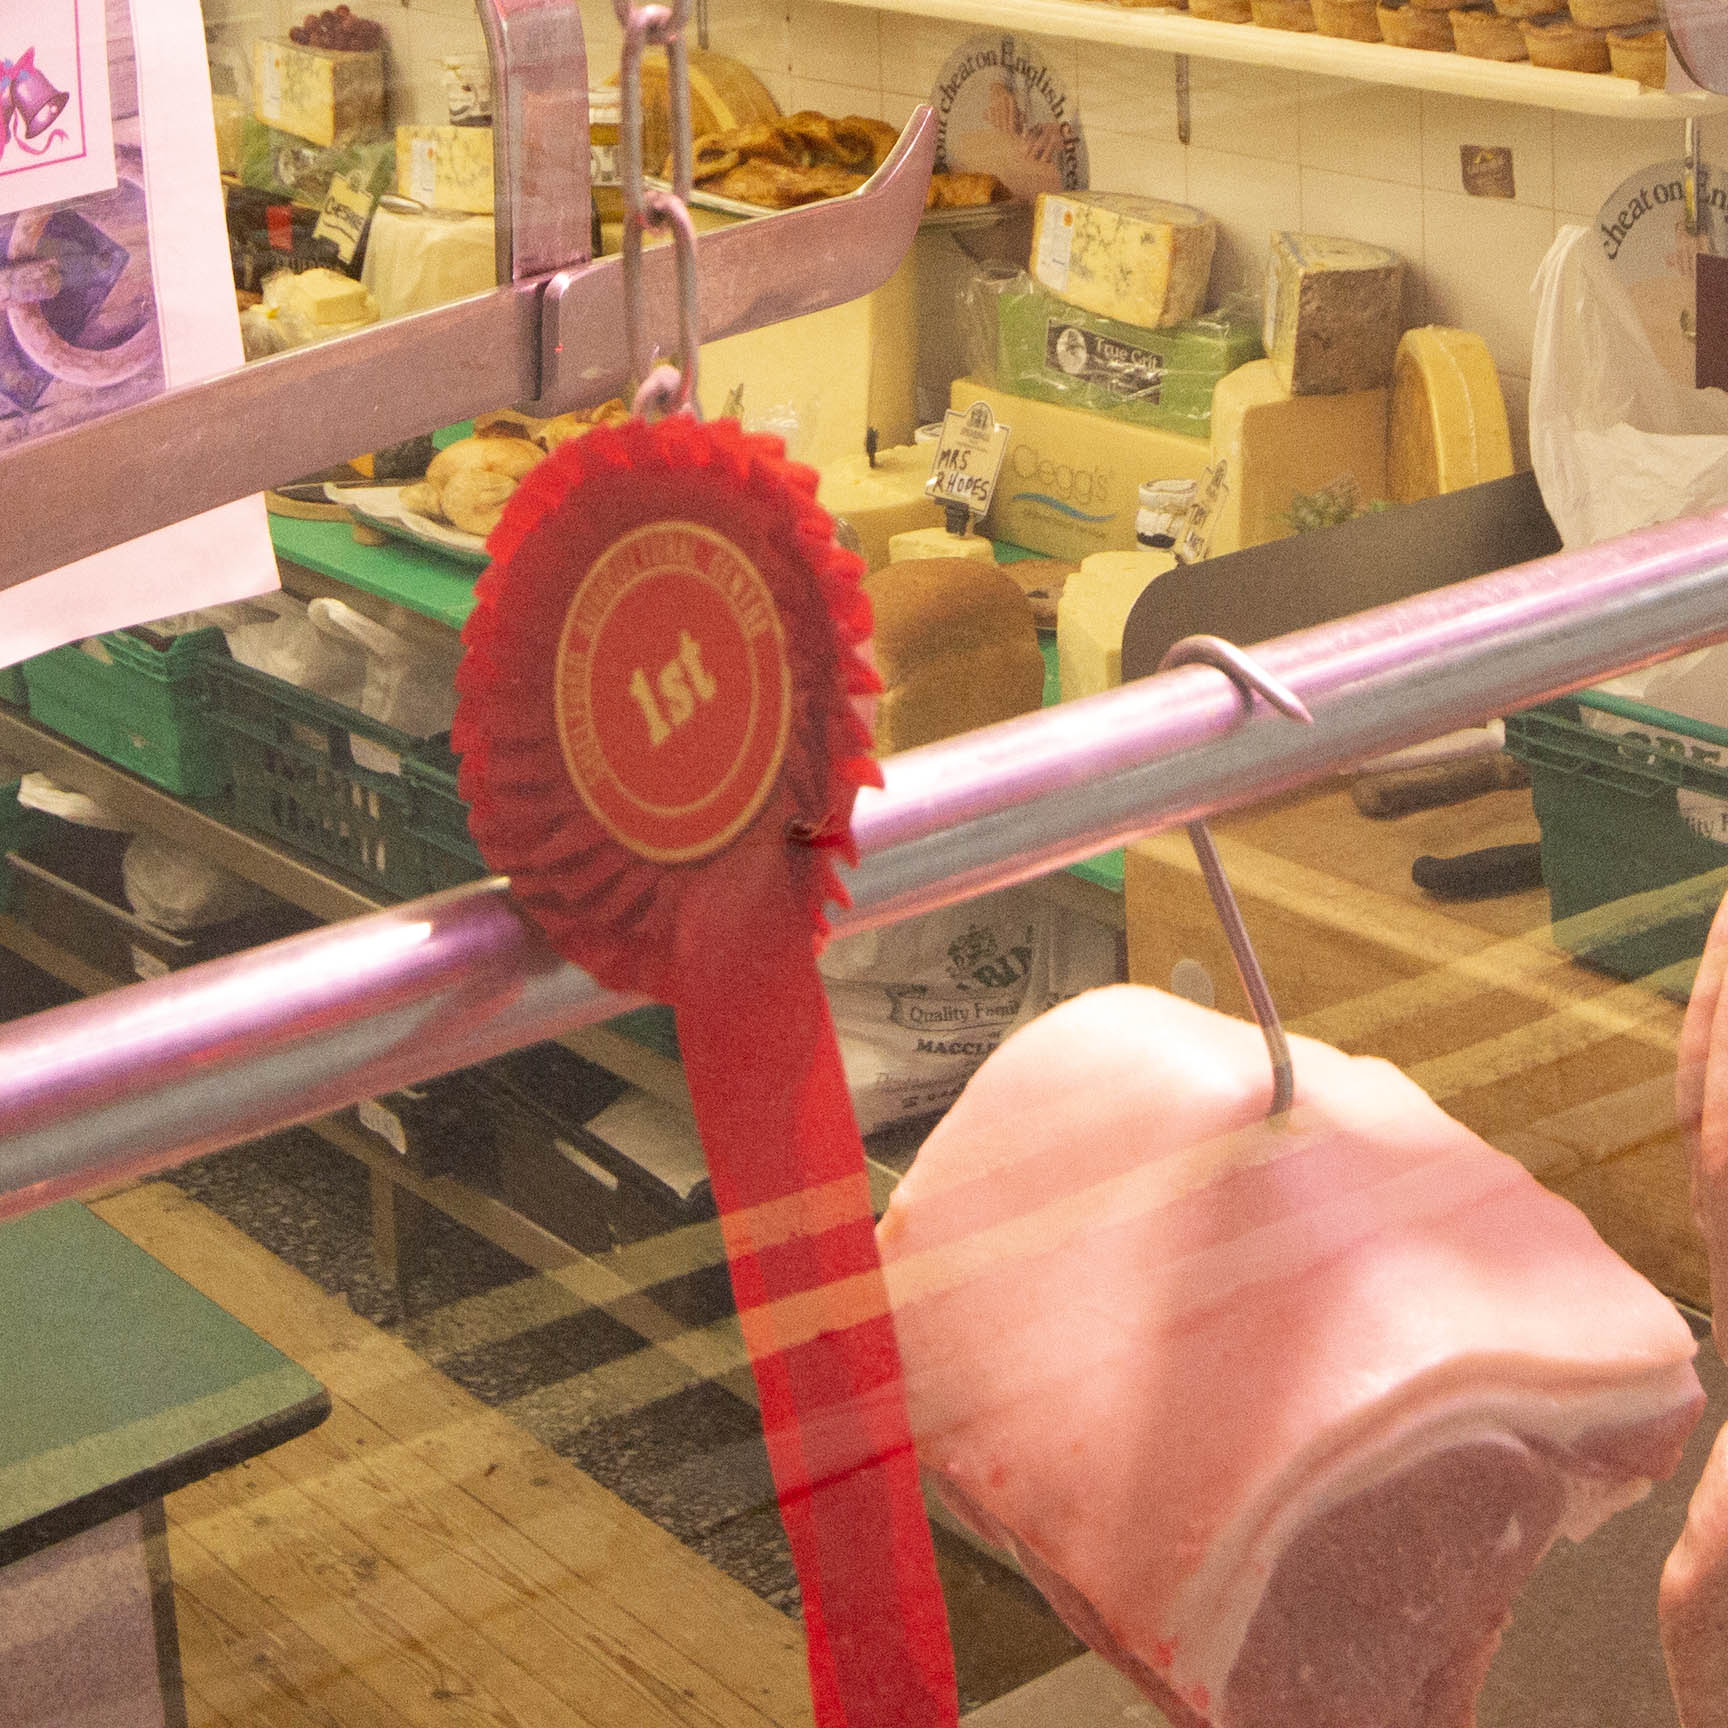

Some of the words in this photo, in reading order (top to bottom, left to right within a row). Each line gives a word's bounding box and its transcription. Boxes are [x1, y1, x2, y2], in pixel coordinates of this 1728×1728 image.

[940, 56, 977, 114] cheat
[975, 49, 997, 69] on
[1000, 38, 1067, 119] English
[1600, 187, 1655, 261] cheat
[1652, 180, 1686, 206] on
[1094, 337, 1128, 360] True
[937, 449, 971, 471] MRS
[628, 629, 718, 748] 1st
[910, 1006, 970, 1025] Quality
